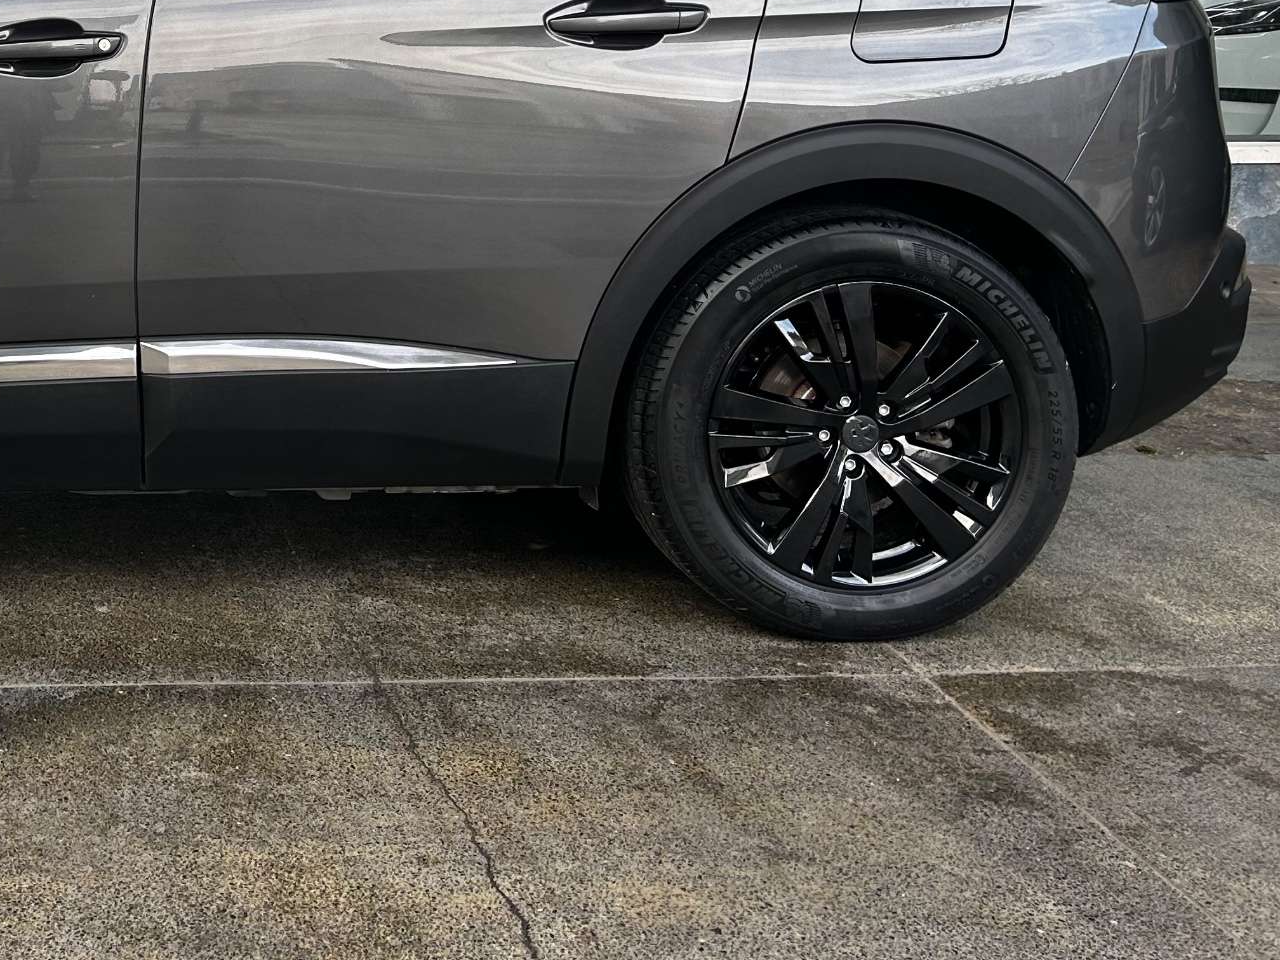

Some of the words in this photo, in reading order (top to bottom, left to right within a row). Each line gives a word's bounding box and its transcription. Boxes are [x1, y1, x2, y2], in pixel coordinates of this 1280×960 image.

[954, 266, 1055, 369] MICHELIN
[1047, 390, 1063, 446] 225/55
[1051, 449, 1061, 461] R
